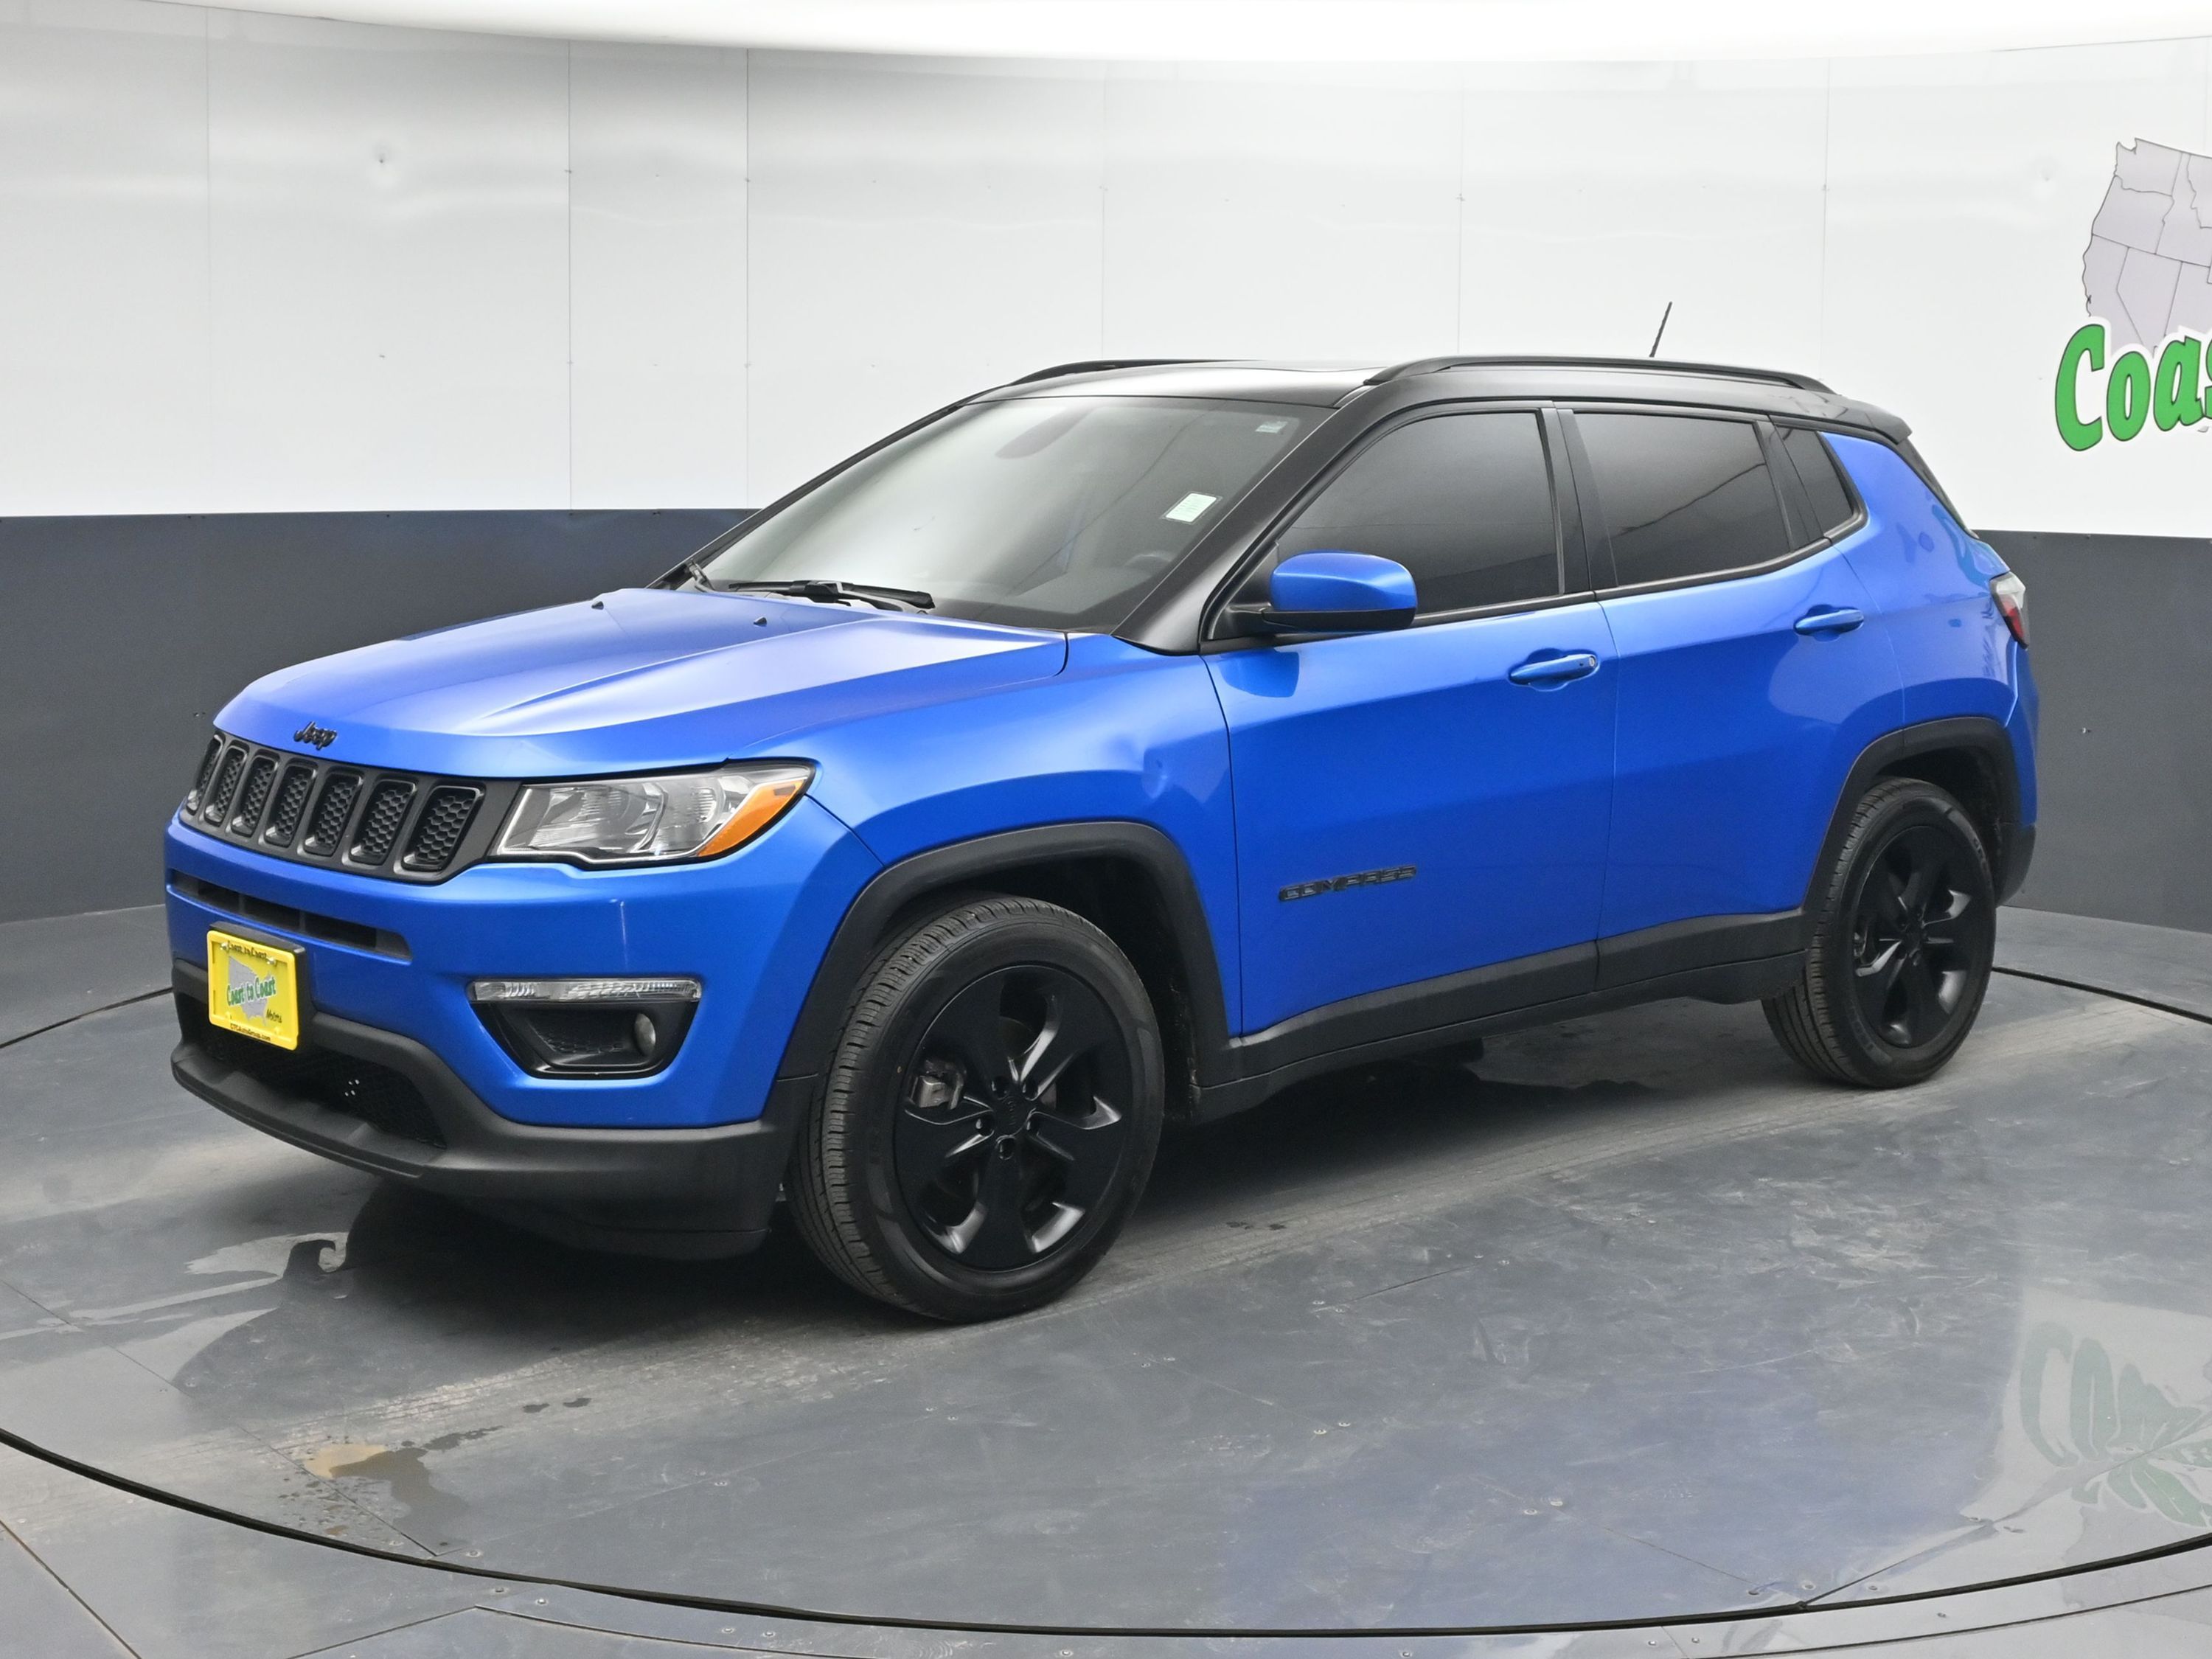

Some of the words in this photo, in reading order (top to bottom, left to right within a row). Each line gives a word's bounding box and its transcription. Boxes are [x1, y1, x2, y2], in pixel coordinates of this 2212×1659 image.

[2054, 323, 2212, 452] Coa
[293, 721, 337, 751] Jeep
[1279, 865, 1416, 901] COMPASS
[227, 984, 245, 1006] Coast
[246, 983, 254, 1001] to
[255, 976, 276, 998] Coast
